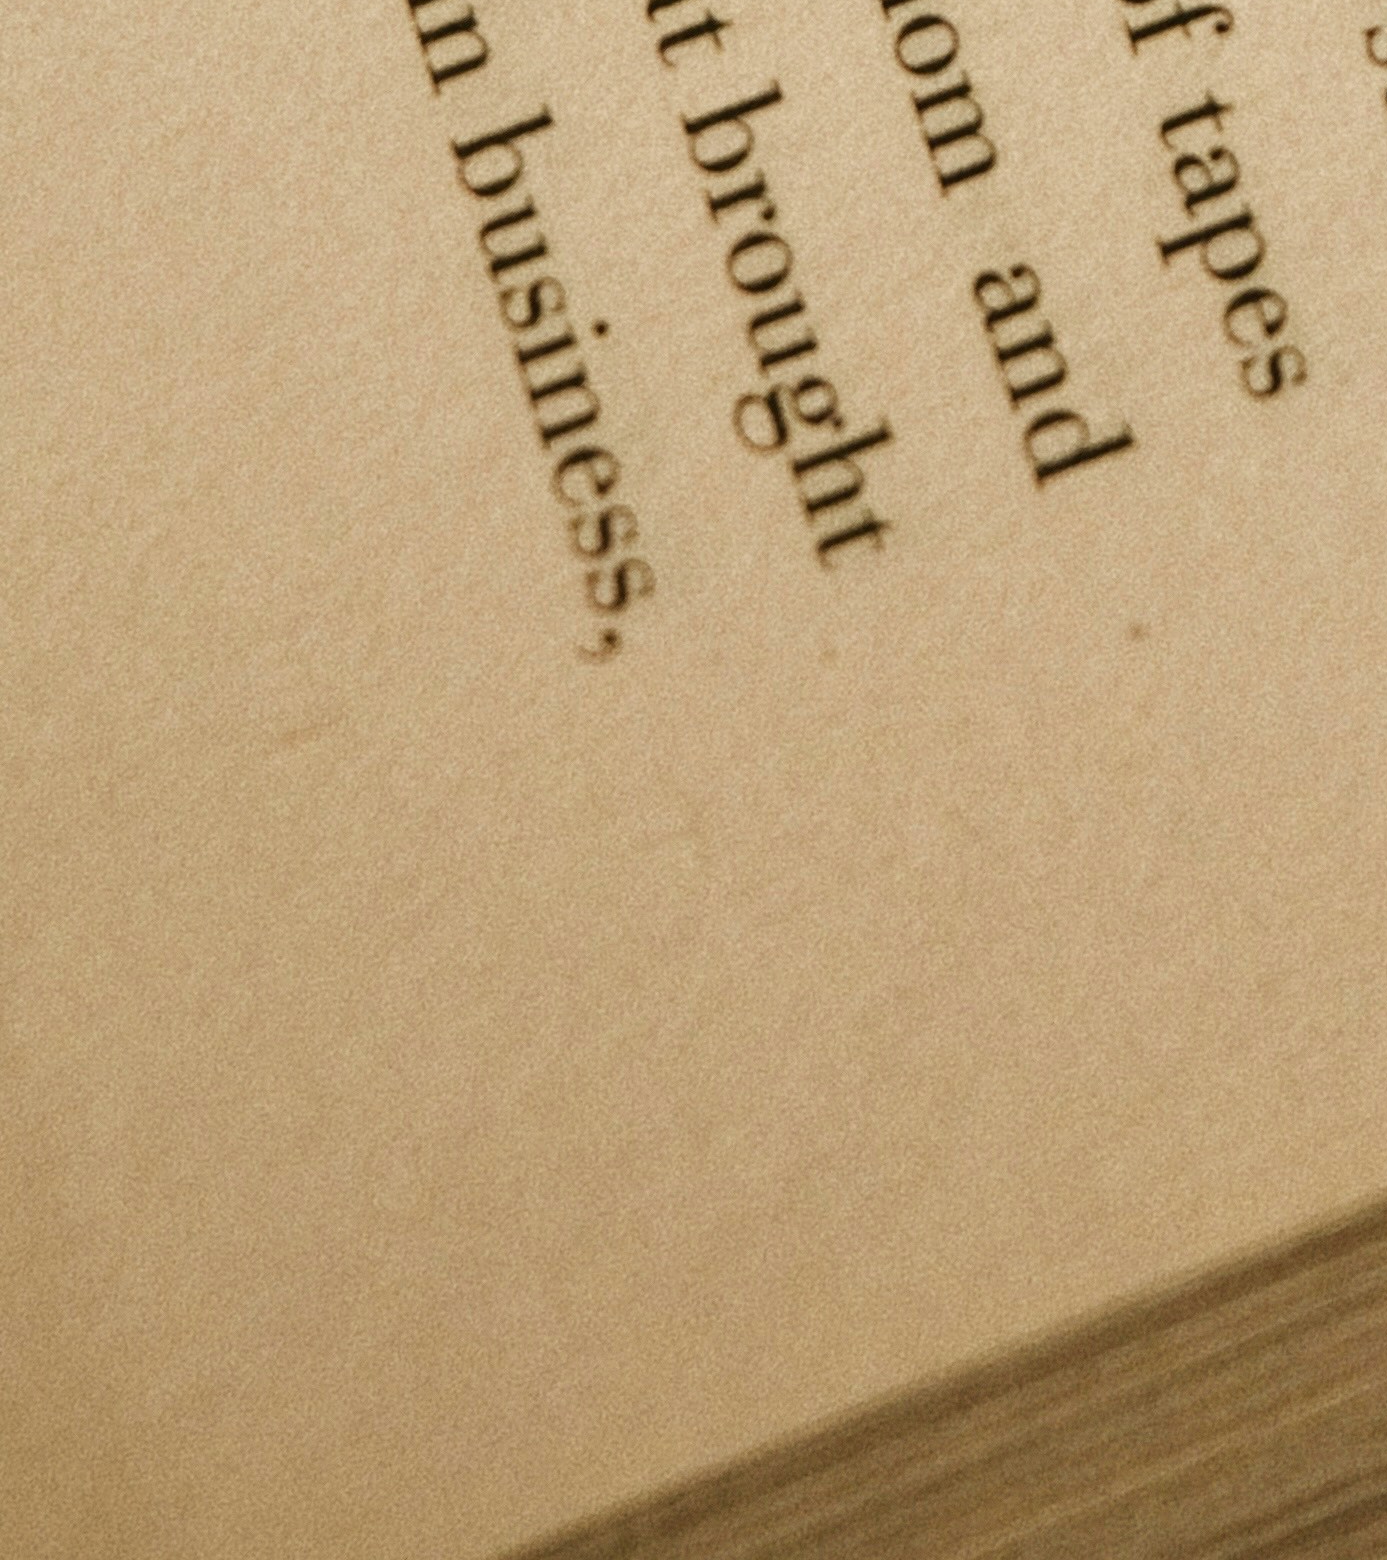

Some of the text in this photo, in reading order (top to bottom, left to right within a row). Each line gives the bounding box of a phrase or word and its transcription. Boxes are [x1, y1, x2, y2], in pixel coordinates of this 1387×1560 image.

[449, 107, 654, 669] business,
[681, 82, 895, 567] brought
[971, 262, 1136, 489] and
[1155, 94, 1308, 401] tapes
